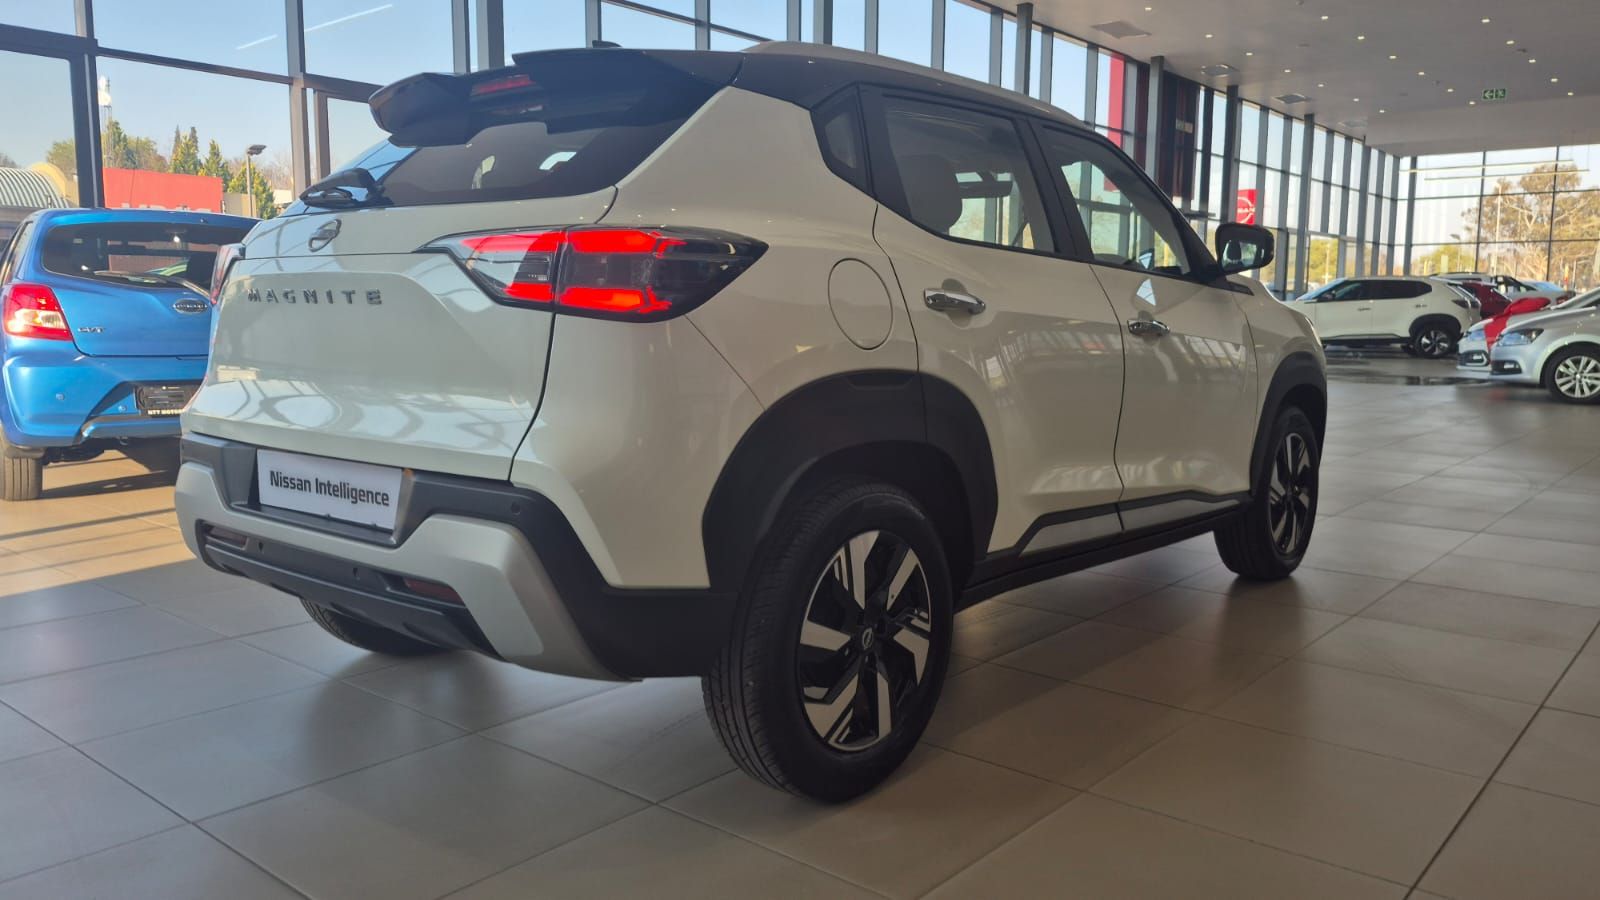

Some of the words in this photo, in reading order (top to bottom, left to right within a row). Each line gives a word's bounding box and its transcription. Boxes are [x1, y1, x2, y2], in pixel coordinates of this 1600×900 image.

[247, 287, 382, 305] MAGNITE
[269, 469, 312, 494] Nissan
[315, 477, 390, 507] Intelligence
